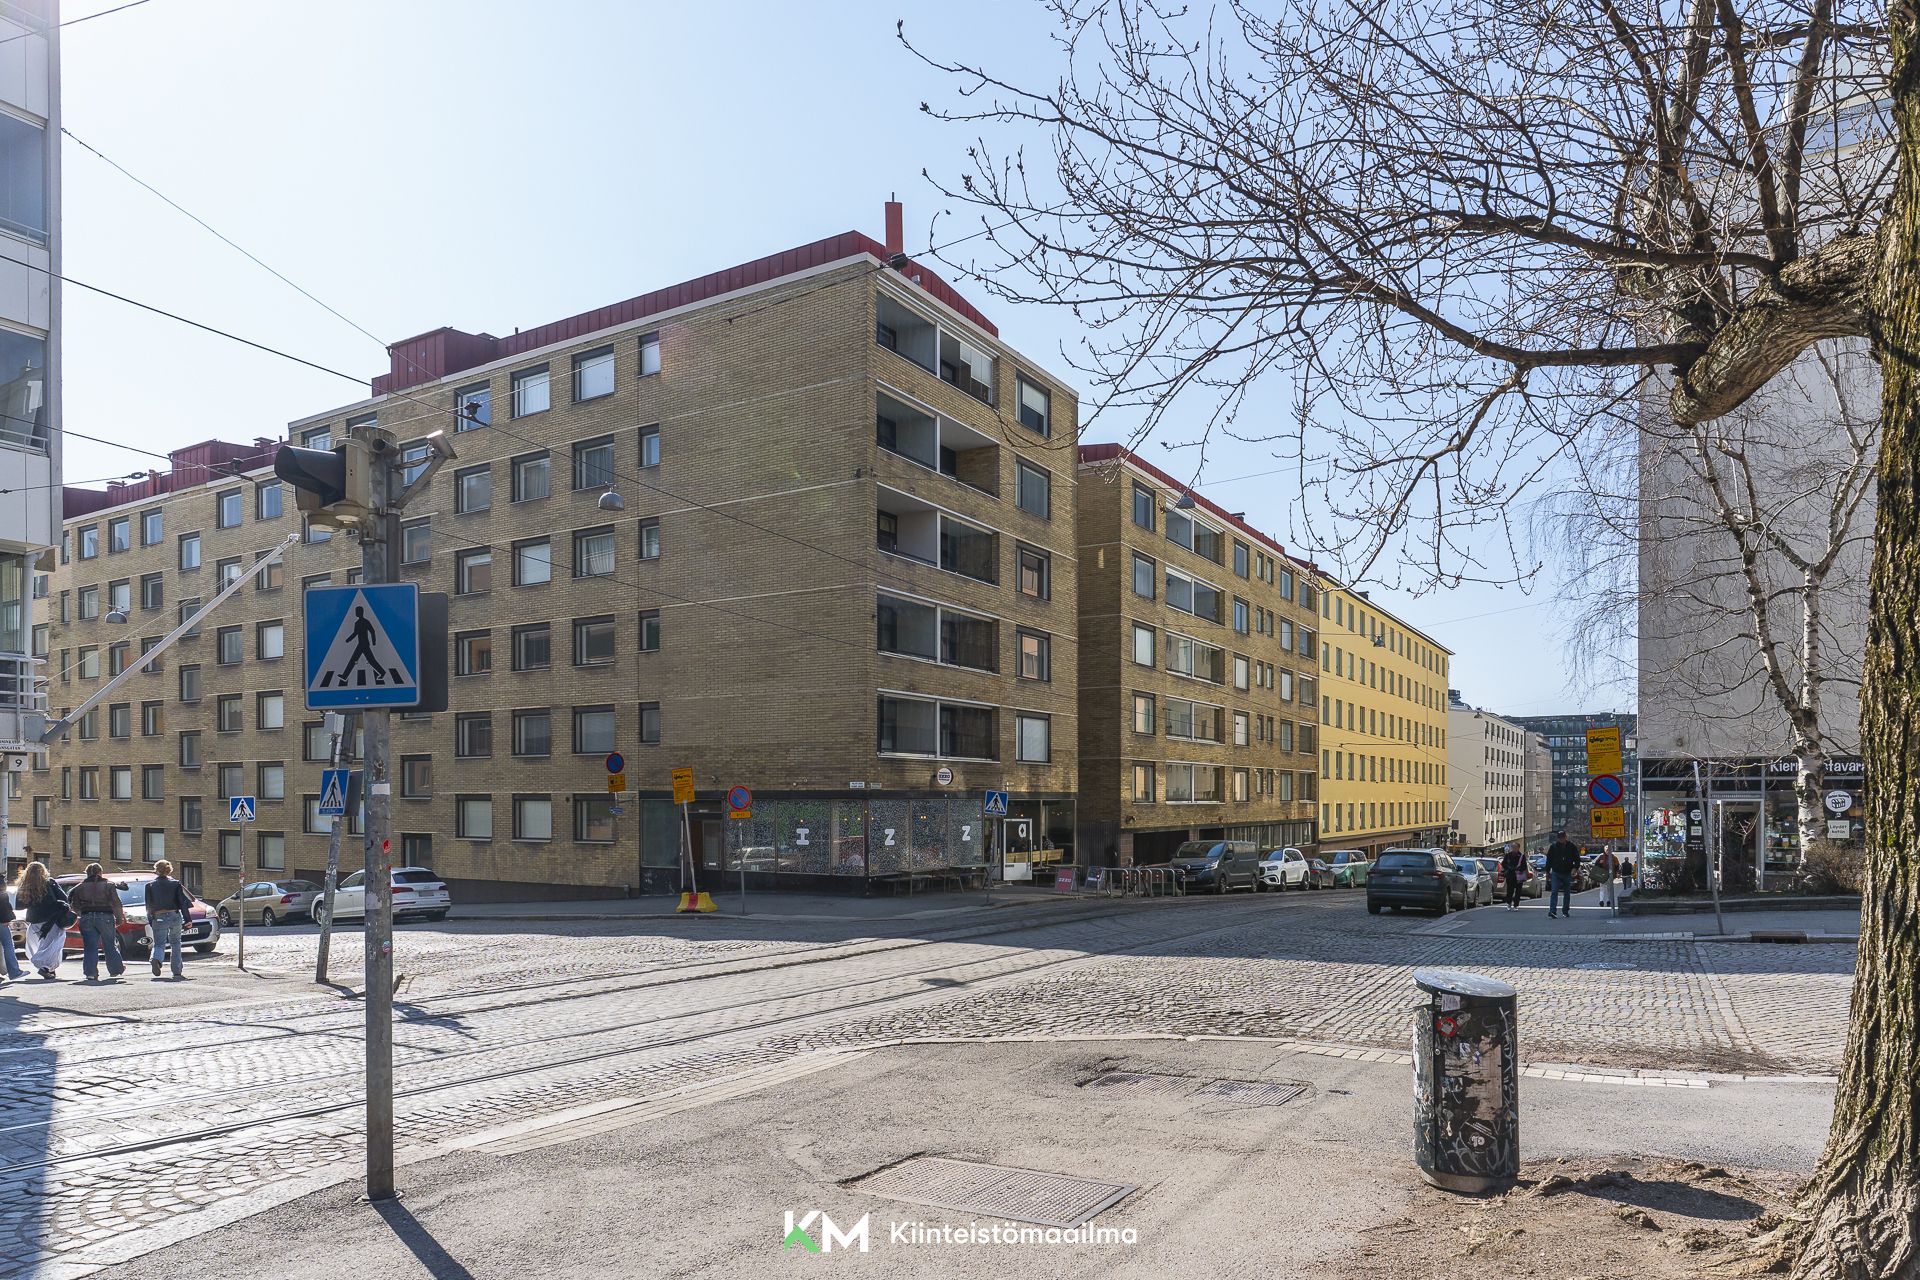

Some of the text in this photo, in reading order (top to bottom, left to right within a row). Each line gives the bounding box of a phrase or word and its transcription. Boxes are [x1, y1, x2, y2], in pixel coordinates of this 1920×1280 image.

[15, 758, 23, 768] 9
[884, 828, 895, 846] Z
[961, 825, 971, 841] Z
